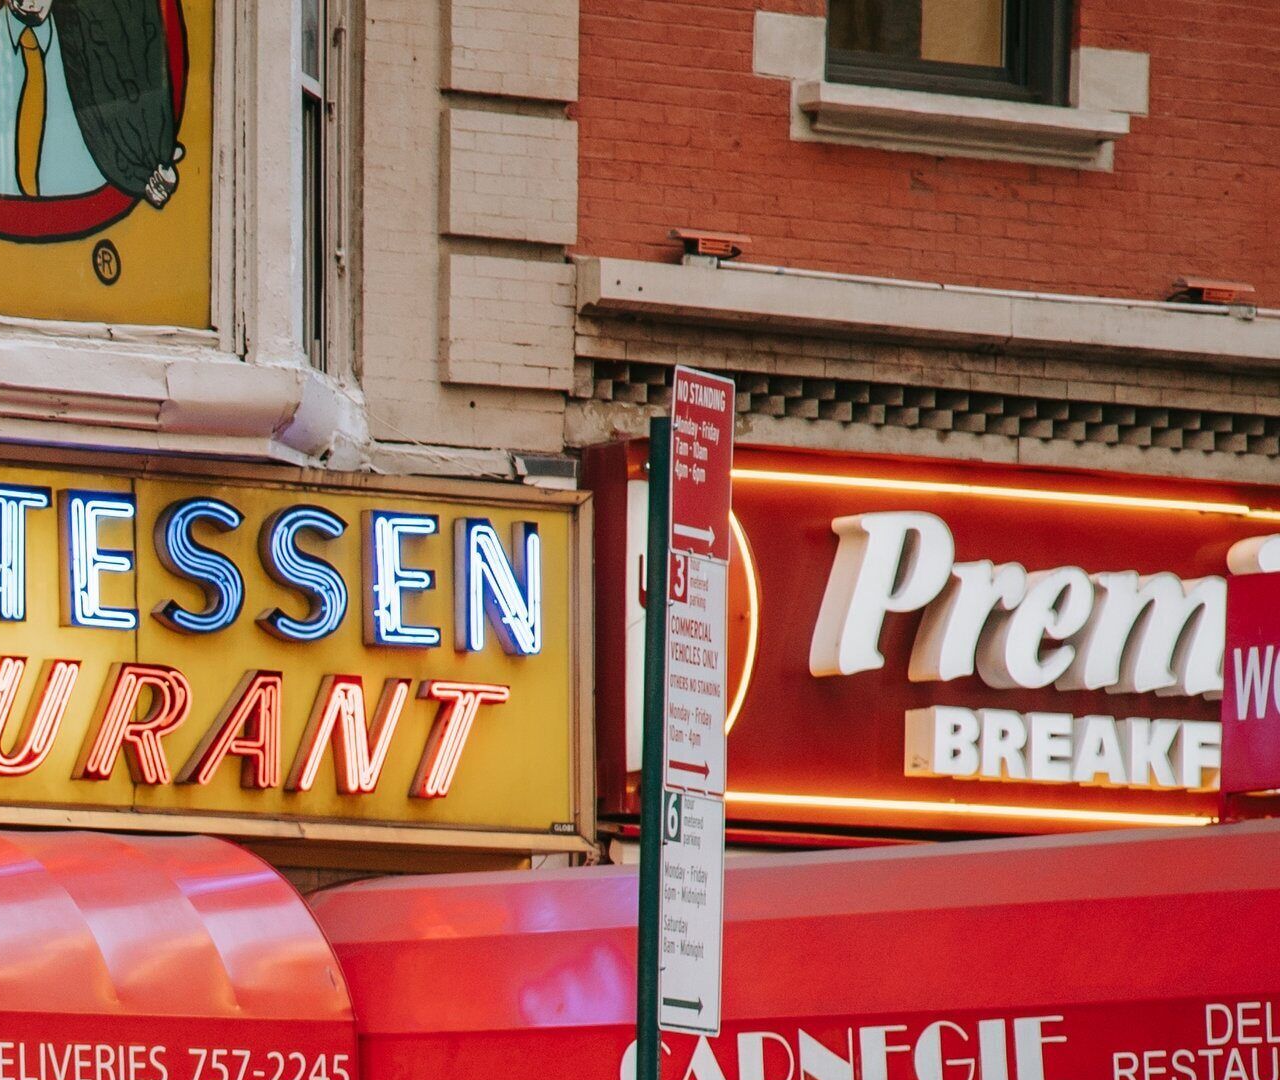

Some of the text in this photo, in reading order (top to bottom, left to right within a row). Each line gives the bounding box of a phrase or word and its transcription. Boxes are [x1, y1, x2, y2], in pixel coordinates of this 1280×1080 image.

[678, 379, 726, 412] NO STANDING
[675, 415, 720, 446] Monday Friday
[676, 437, 708, 460] 7am 10am
[674, 553, 685, 597] 3
[812, 509, 1227, 701] Prem
[671, 616, 712, 643] COMMERCIAL
[671, 641, 718, 670] VEHICLES ONLY
[670, 674, 720, 697] OTHERS NO STANDING
[669, 702, 712, 729] Monday Friday
[668, 793, 678, 838] 6
[664, 861, 708, 885] Monday Friday
[682, 886, 706, 908] Midnight
[663, 914, 688, 937] Saturday
[681, 939, 704, 962] Midnight
[1206, 1002, 1280, 1046] DEL
